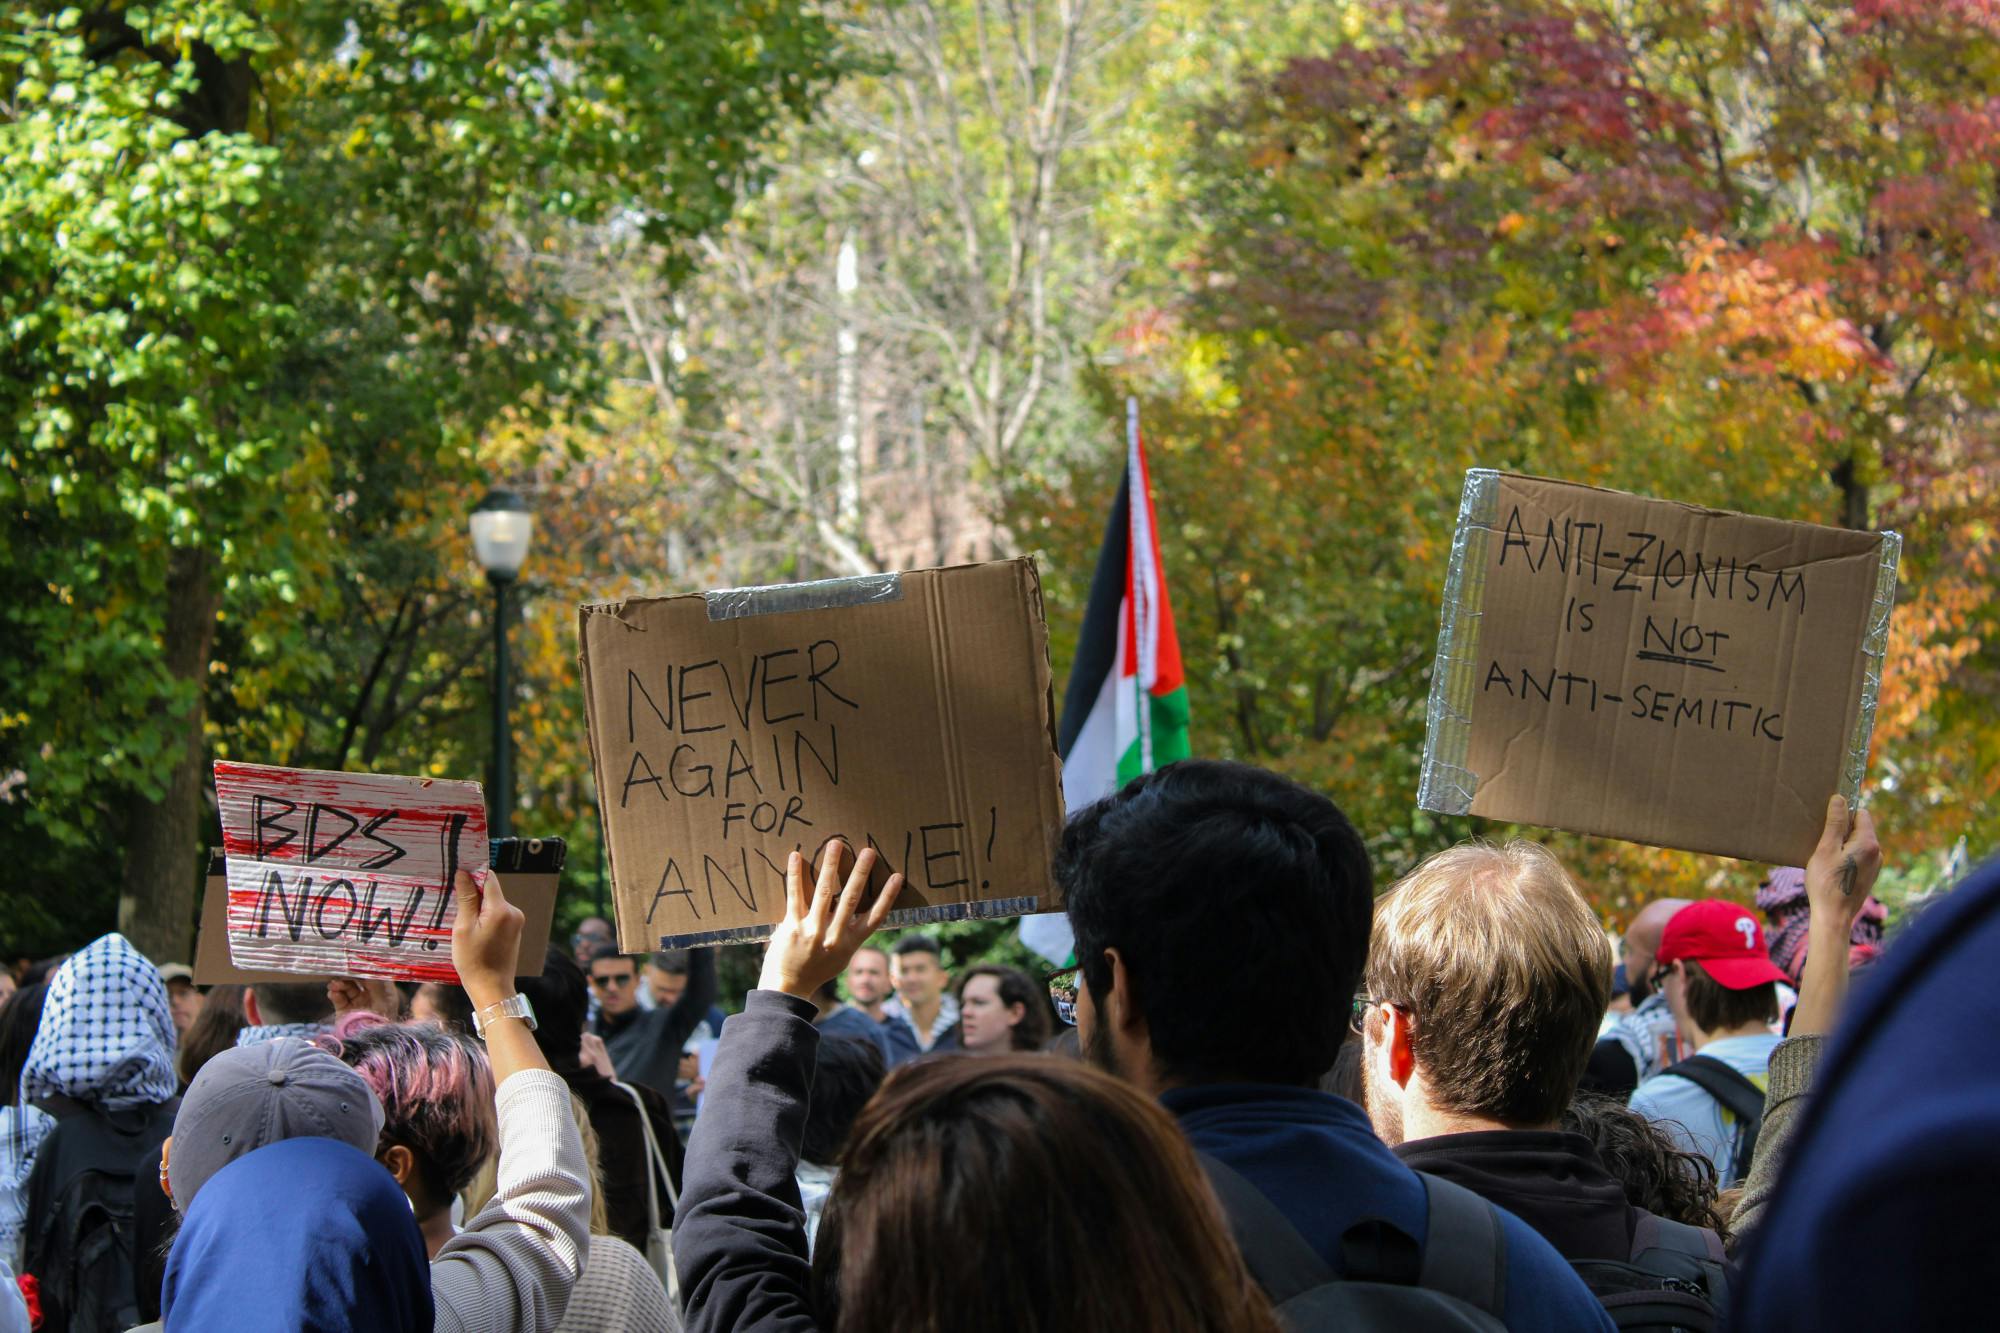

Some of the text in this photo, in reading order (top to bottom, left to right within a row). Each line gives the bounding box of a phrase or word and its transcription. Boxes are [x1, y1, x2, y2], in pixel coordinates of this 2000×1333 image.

[1499, 504, 1806, 614] ANTI-ZIONISM
[1566, 596, 1730, 656] IS NOT
[627, 639, 859, 742] NEVER
[1484, 660, 1784, 741] ANTI-SEMITIC
[621, 724, 839, 808] AGAIN
[251, 794, 407, 869] BDS
[722, 795, 813, 839] FOR
